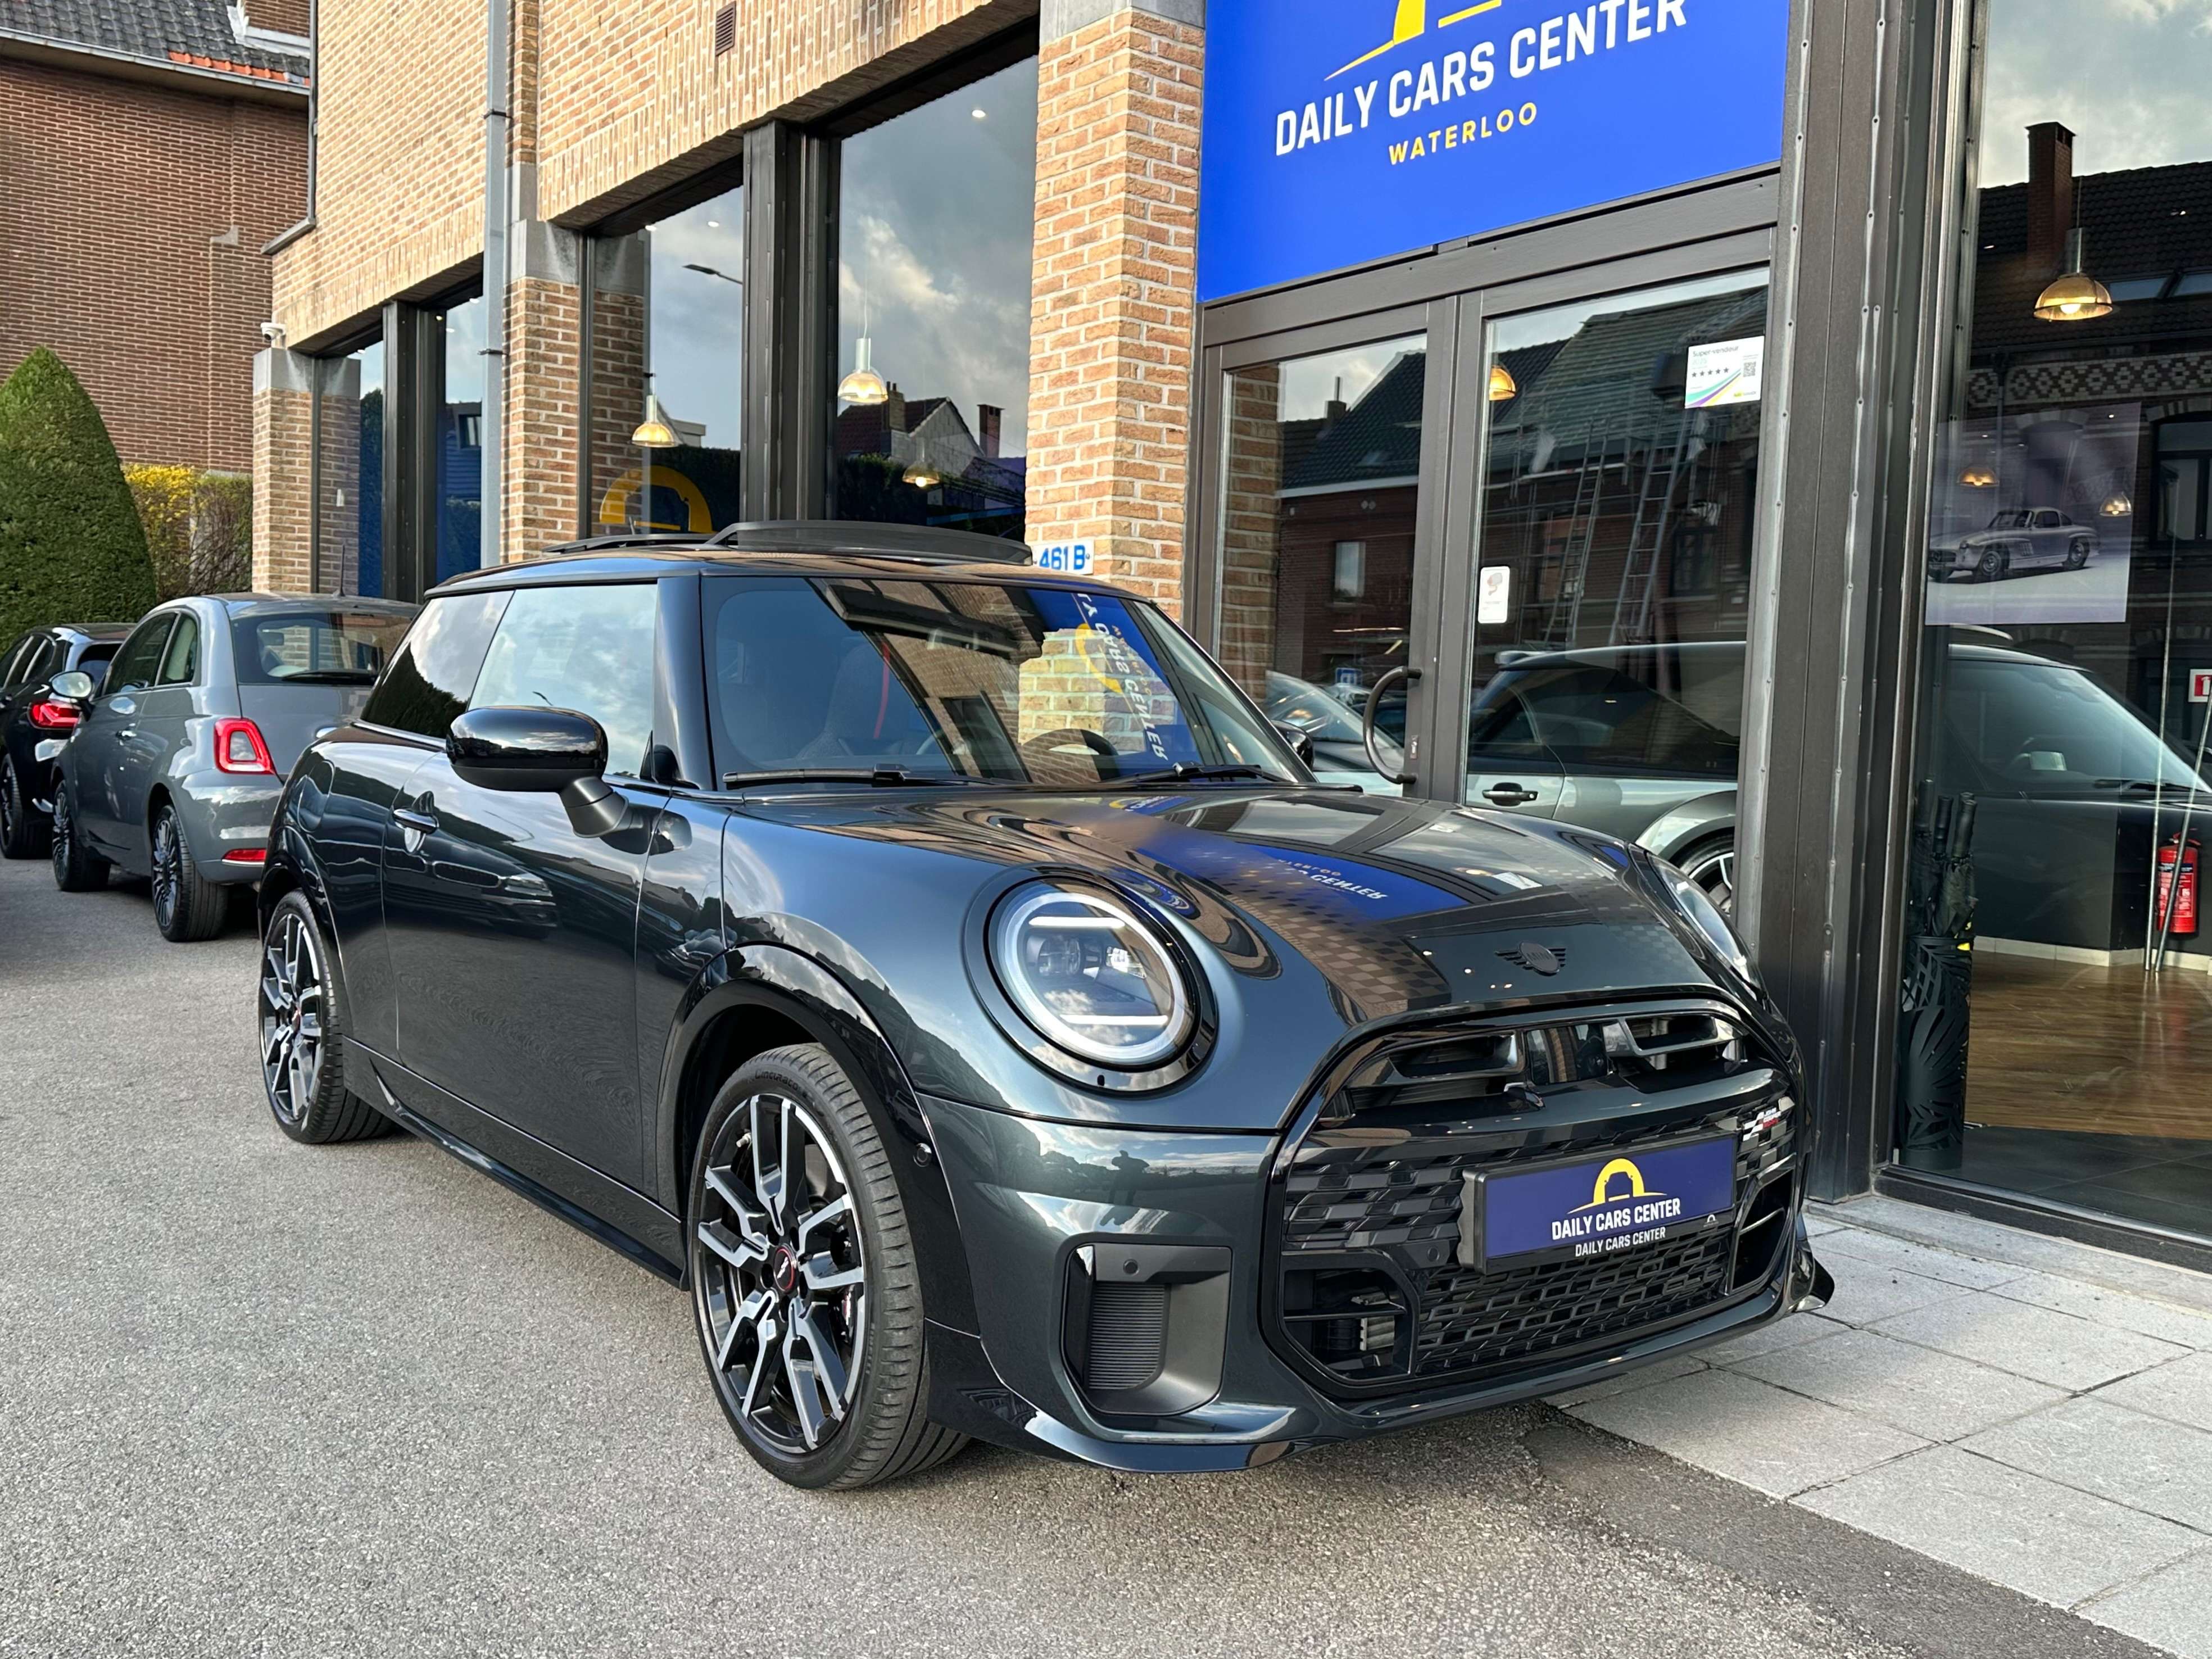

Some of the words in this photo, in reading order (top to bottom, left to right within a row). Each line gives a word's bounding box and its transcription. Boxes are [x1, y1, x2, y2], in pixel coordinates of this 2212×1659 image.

[1276, 80, 1378, 157] DAILY
[1388, 40, 1494, 118] CARS
[1509, 0, 1688, 79] CENTER
[1388, 102, 1538, 166] WATERLOO
[1692, 346, 1739, 357] Super-vendeur
[1039, 545, 1069, 571] 461
[1073, 545, 1086, 570] B
[1552, 1216, 1593, 1240] DAILY
[1595, 1210, 1631, 1231] CARS
[1634, 1198, 1681, 1223] CENTER
[1575, 1239, 1603, 1257] DAILY
[1605, 1234, 1631, 1251] CARS
[1633, 1226, 1666, 1245] CENTER
